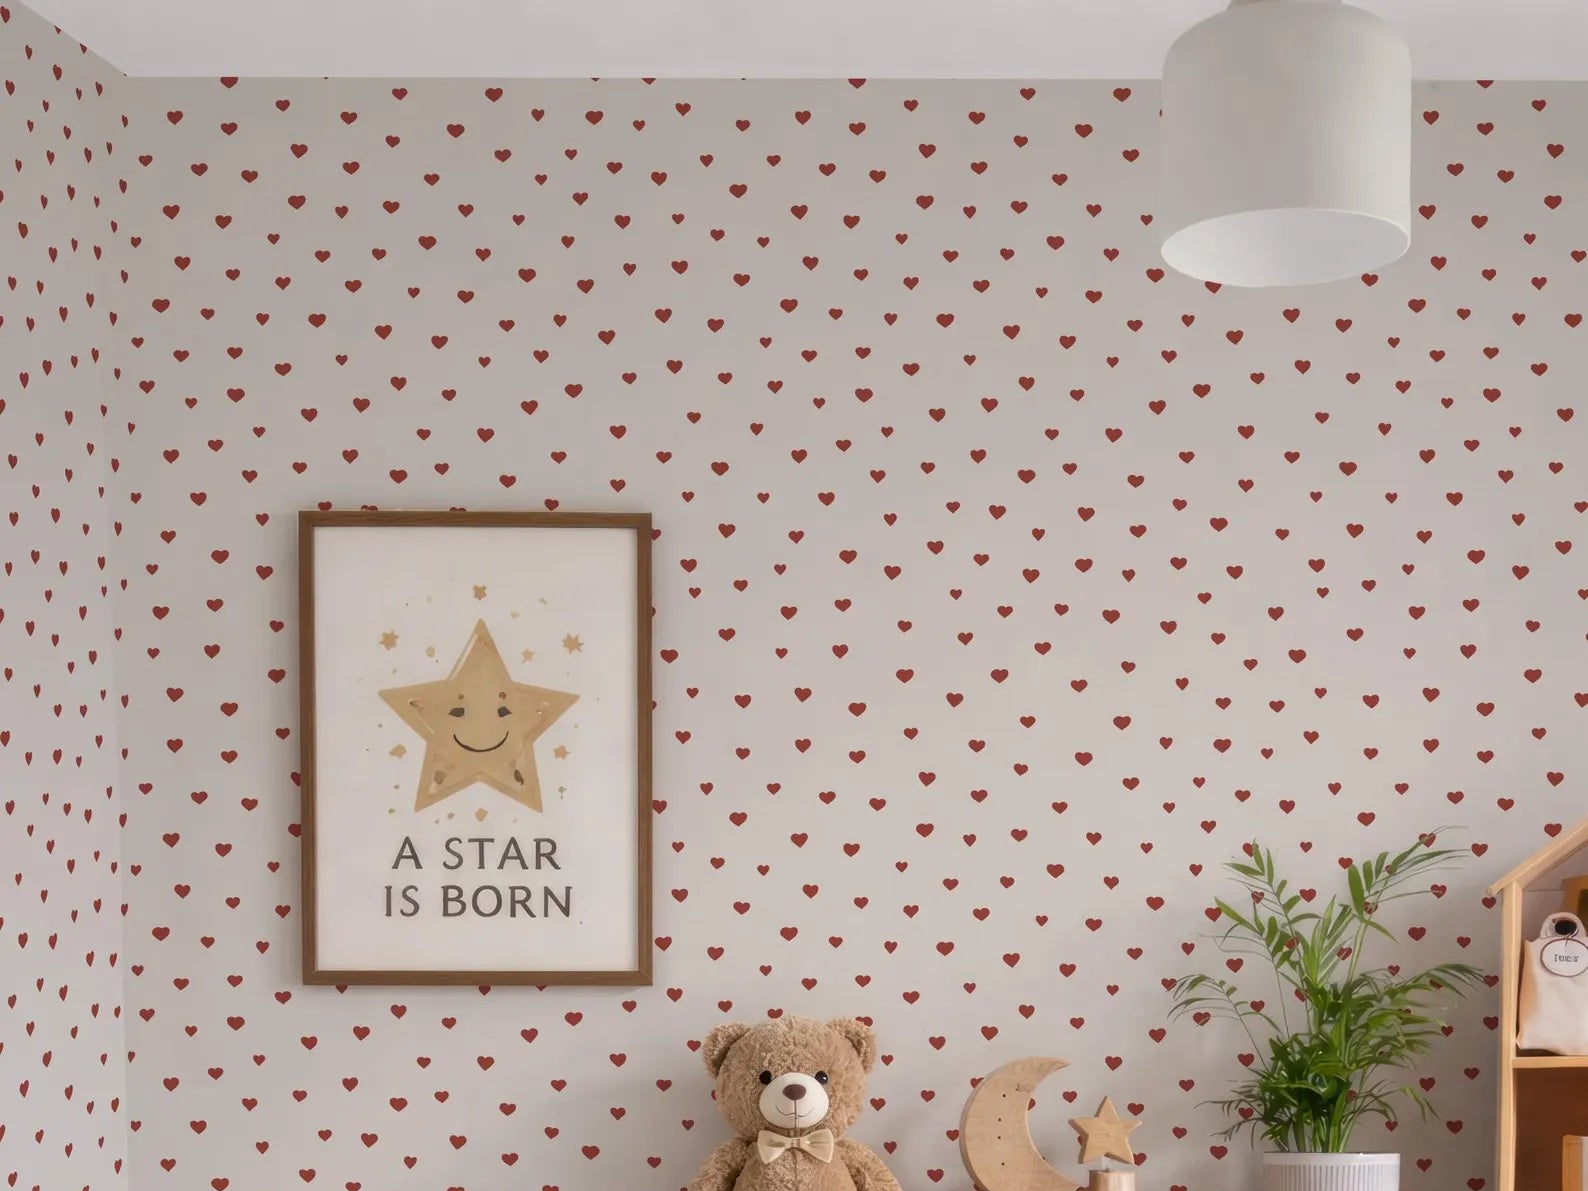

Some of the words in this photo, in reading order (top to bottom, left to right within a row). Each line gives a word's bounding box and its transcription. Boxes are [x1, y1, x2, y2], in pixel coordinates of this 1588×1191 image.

[391, 835, 423, 870] A
[442, 836, 562, 871] STAR
[384, 884, 420, 918] IS
[440, 884, 573, 918] BORN
